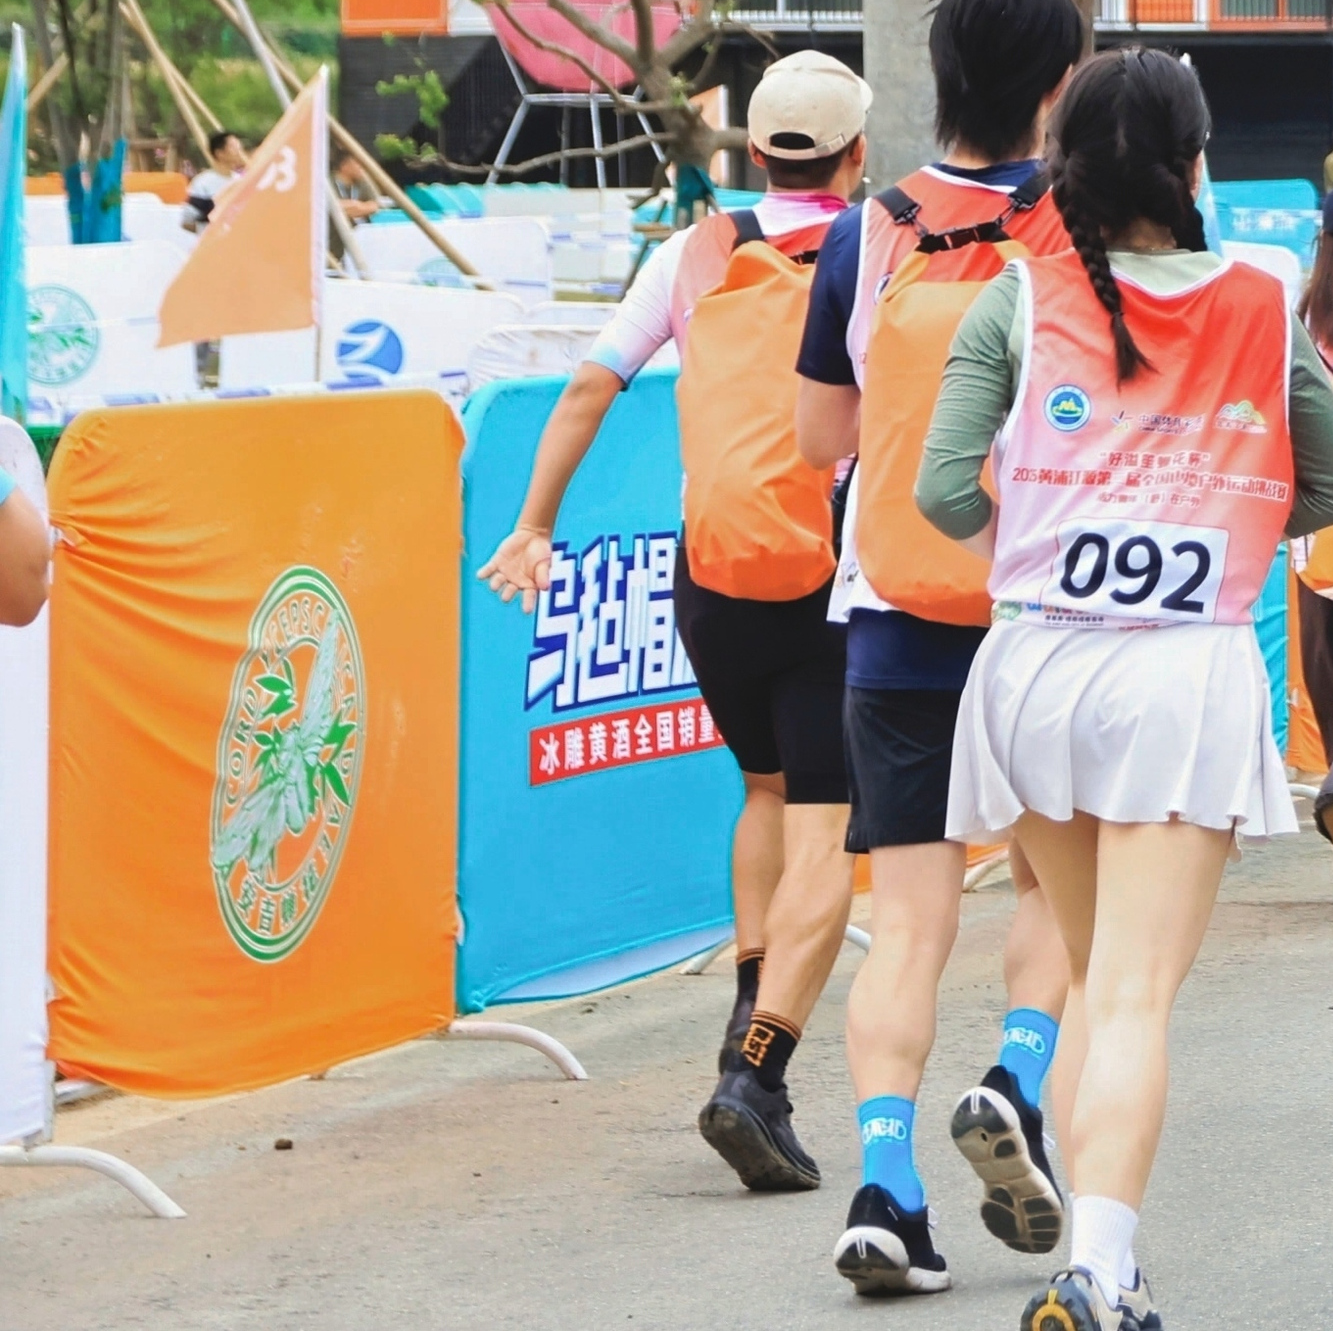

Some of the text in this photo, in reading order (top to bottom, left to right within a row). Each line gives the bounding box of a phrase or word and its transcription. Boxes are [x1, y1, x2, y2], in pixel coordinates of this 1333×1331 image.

[1061, 532, 1211, 613] 092
[526, 534, 699, 710] 乌毡帽
[538, 704, 722, 775] 冰雕黄酒全国销量
